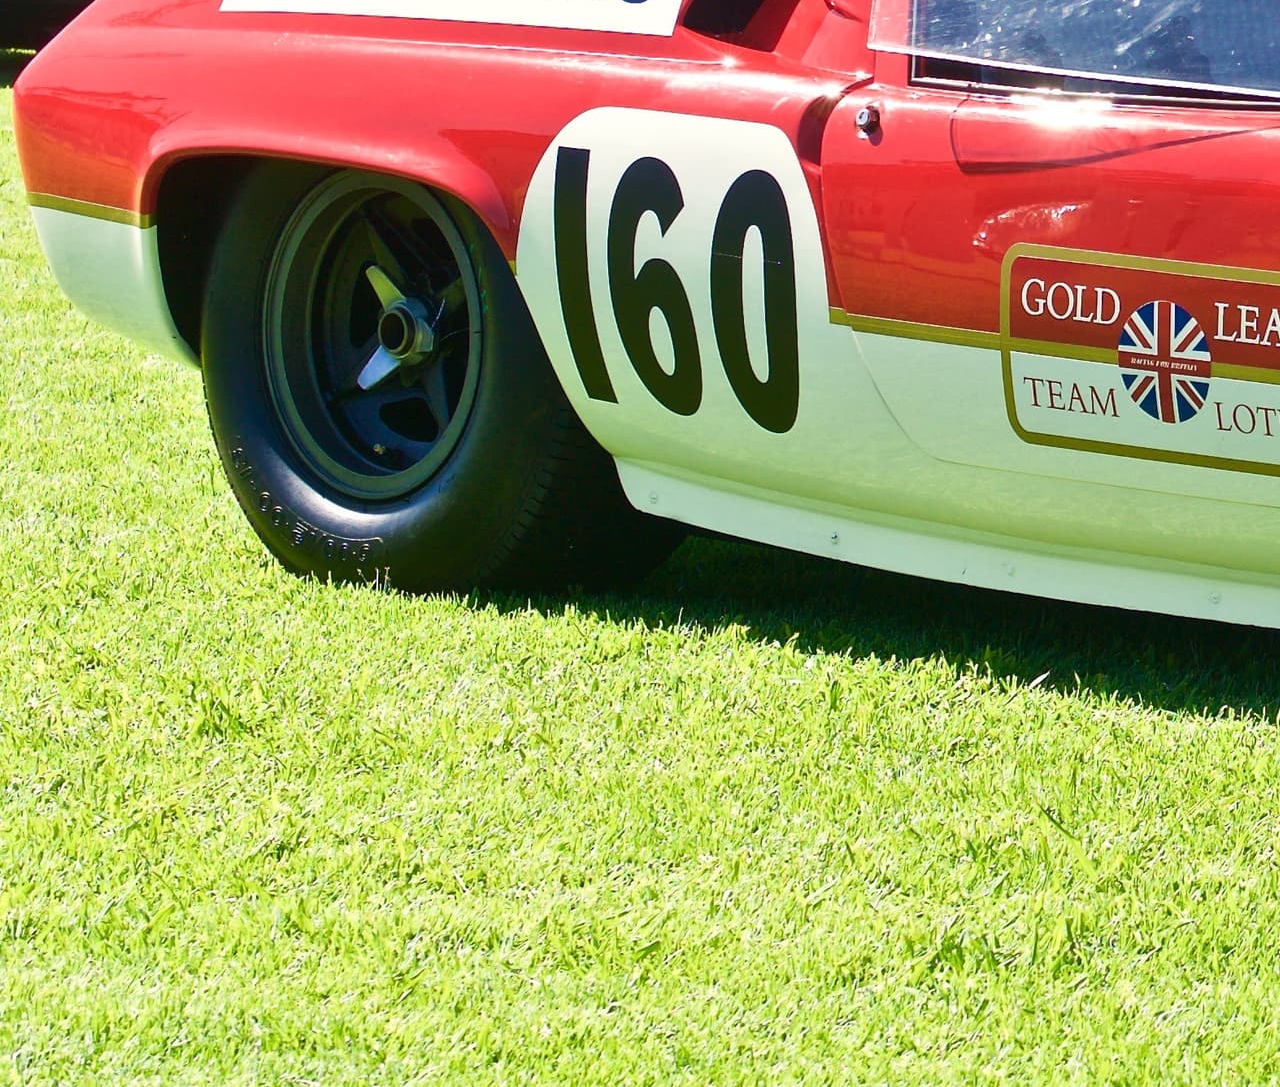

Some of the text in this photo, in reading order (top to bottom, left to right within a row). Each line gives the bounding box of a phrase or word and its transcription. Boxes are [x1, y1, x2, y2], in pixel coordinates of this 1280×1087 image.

[554, 145, 799, 434] 160
[1021, 278, 1121, 325] GOLD
[1023, 376, 1120, 418] TEAM
